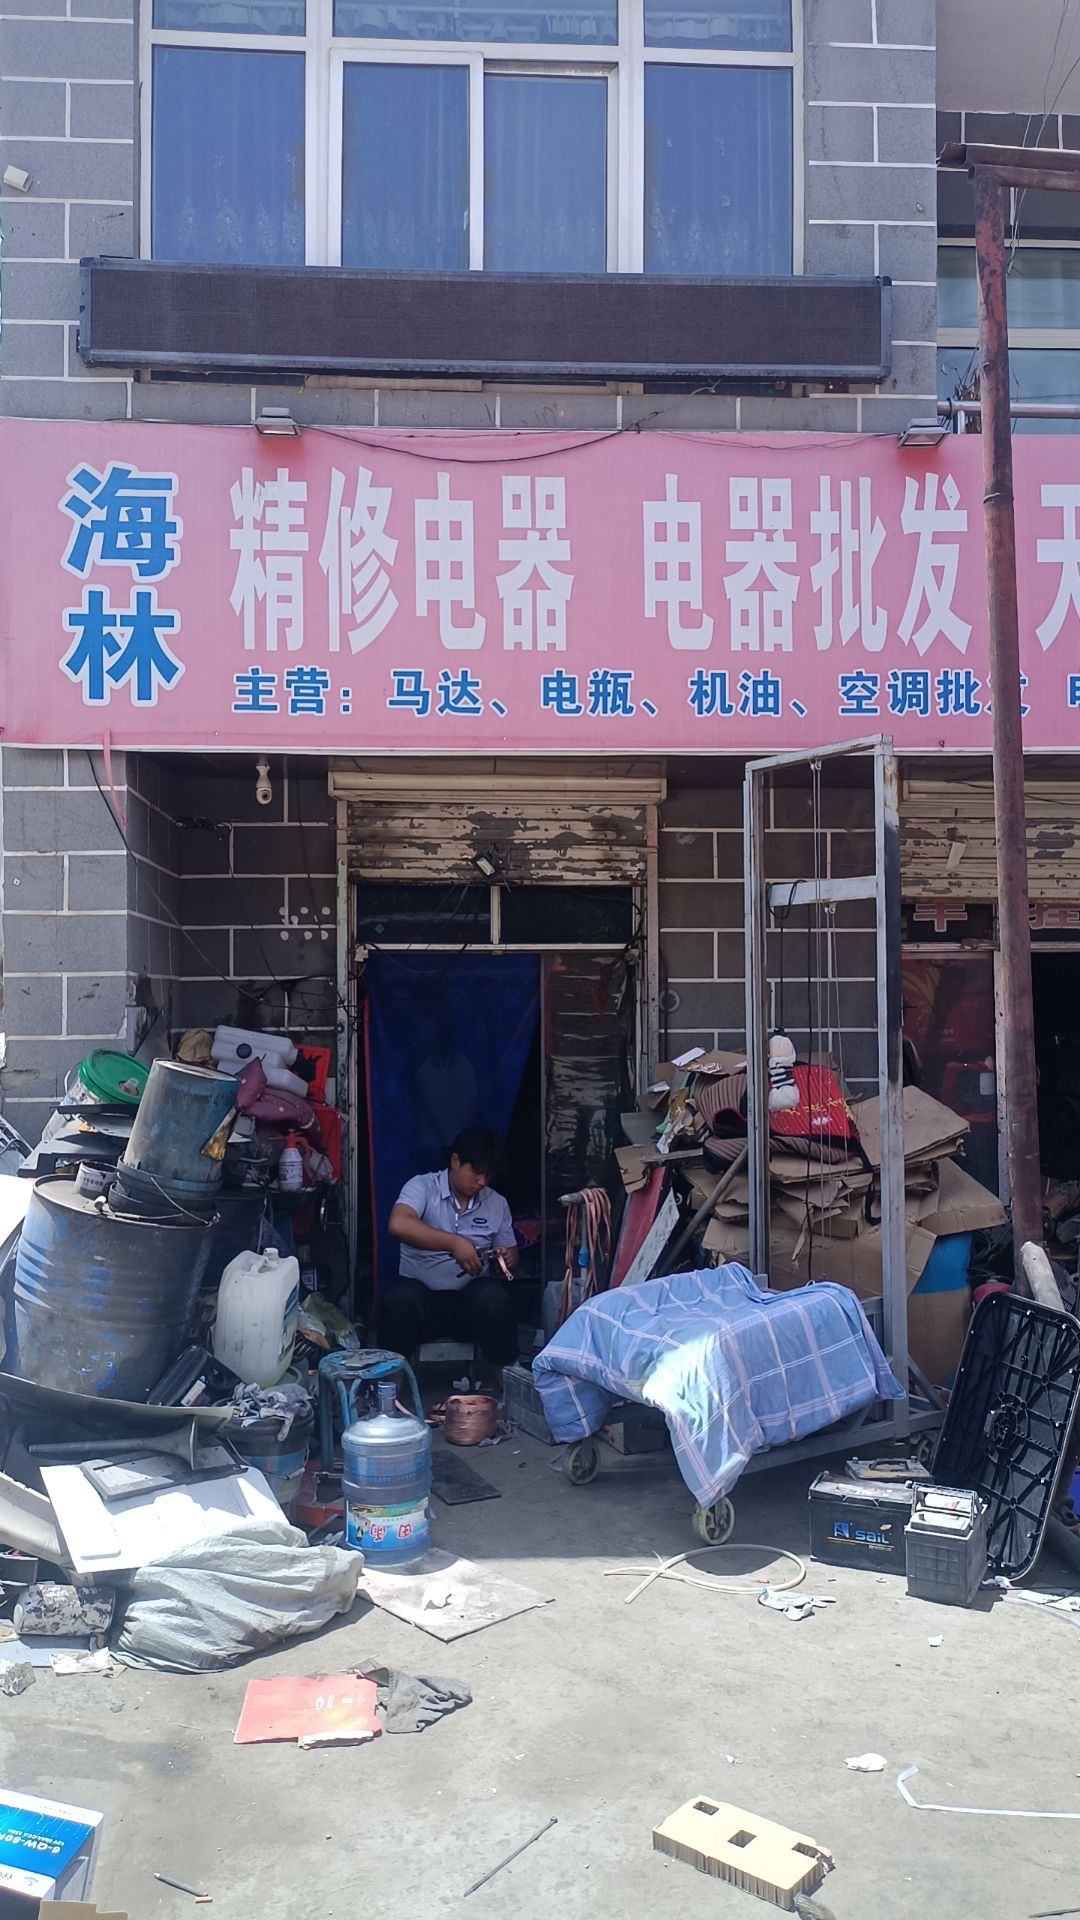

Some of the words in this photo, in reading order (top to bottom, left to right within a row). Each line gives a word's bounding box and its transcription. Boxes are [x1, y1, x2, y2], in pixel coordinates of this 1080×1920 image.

[60, 461, 185, 706] 海林
[229, 466, 574, 654] 精修电器
[642, 472, 973, 656] 电器批发
